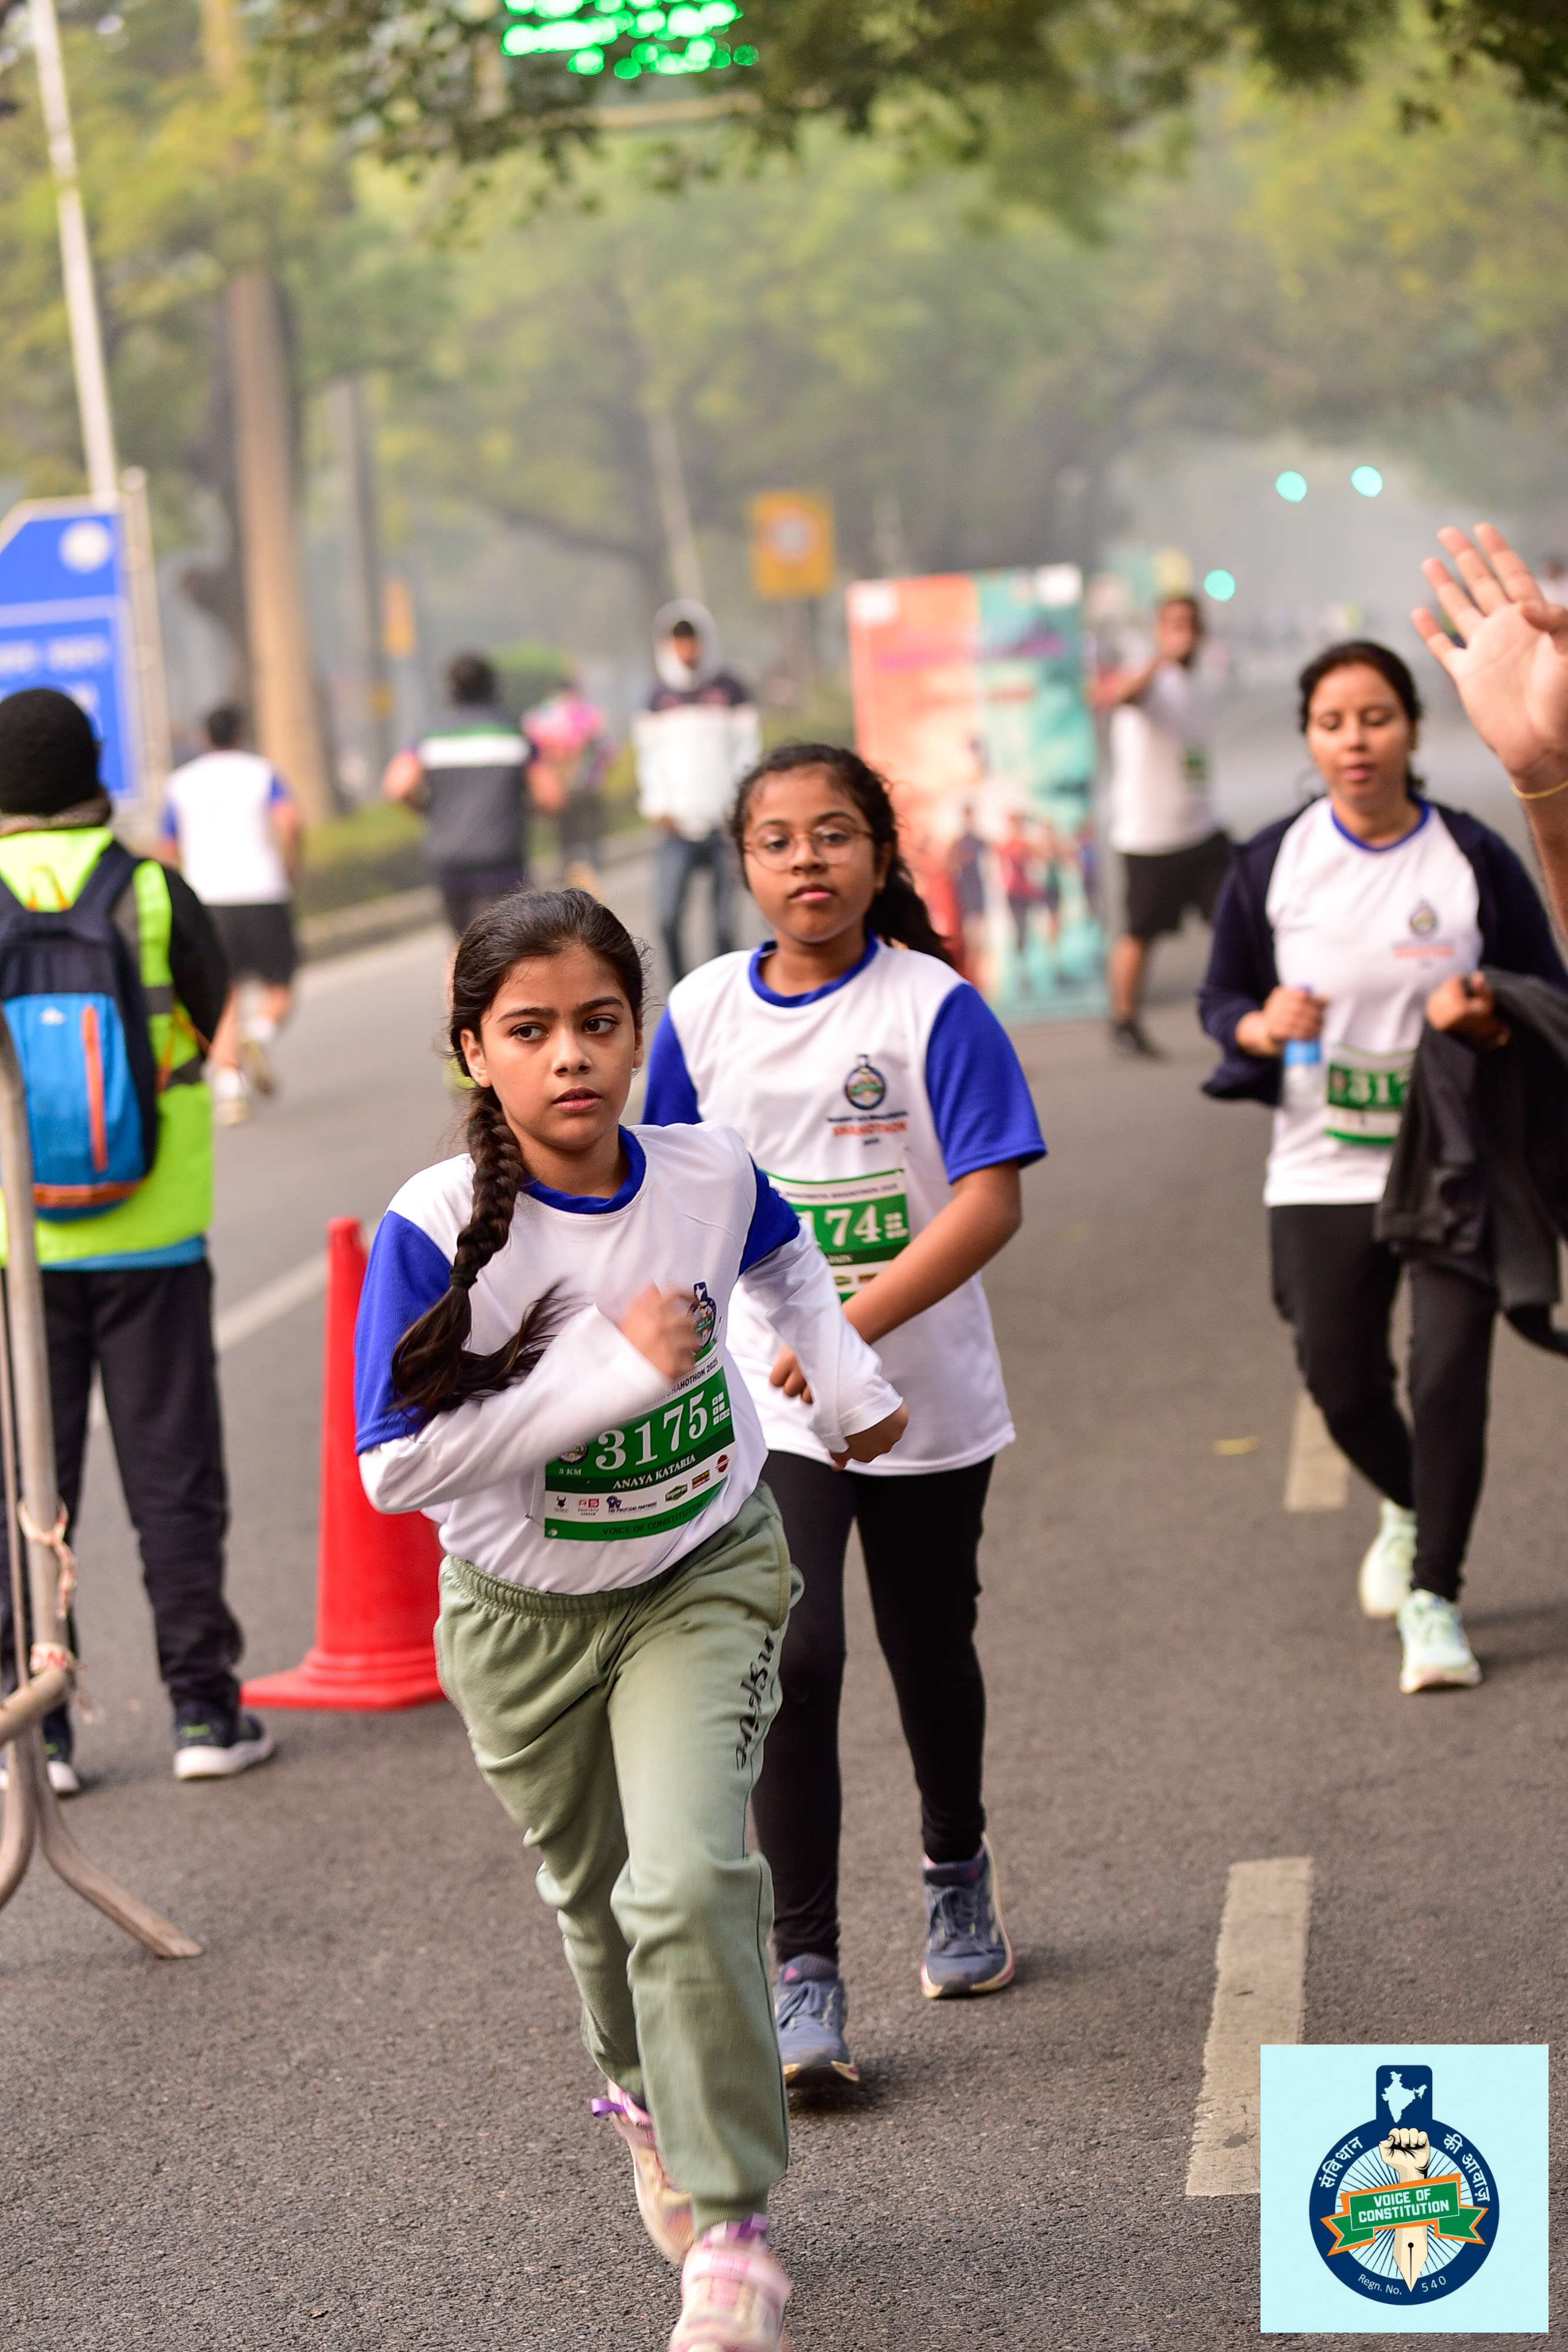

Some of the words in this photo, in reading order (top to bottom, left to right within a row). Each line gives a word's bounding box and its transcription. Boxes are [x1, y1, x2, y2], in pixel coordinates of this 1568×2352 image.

[595, 1389, 708, 1471] 3175
[566, 1468, 582, 1476] KM
[613, 1473, 653, 1489] ANAYA
[655, 1454, 696, 1481] KATARIA
[603, 1527, 629, 1535] VOICE
[647, 1500, 704, 1530] CONSTITUTION
